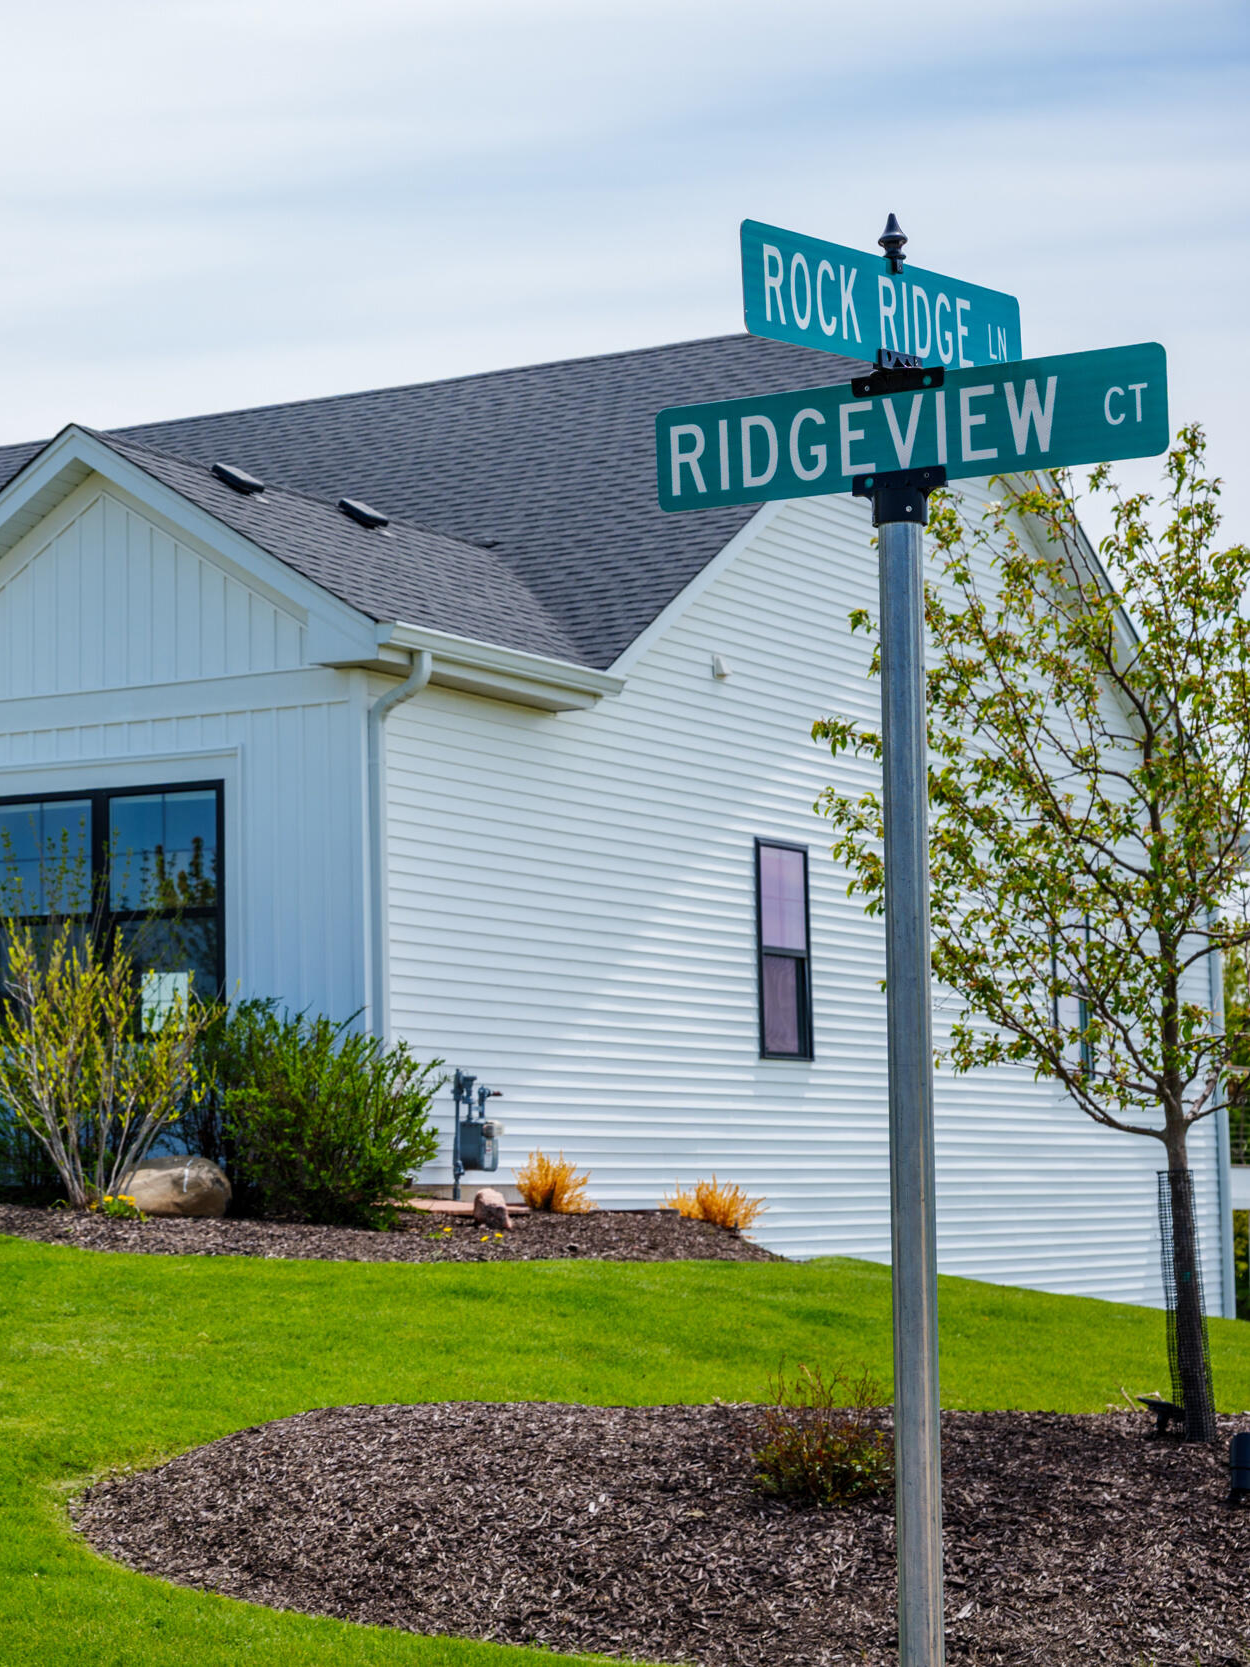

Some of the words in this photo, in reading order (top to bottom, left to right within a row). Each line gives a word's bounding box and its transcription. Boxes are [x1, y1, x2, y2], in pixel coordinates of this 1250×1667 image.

[762, 243, 862, 344] ROCK
[877, 274, 975, 368] RIDGE
[987, 323, 1008, 363] LN
[669, 375, 1058, 497] RIDGEVIEW
[1103, 382, 1149, 426] CT
